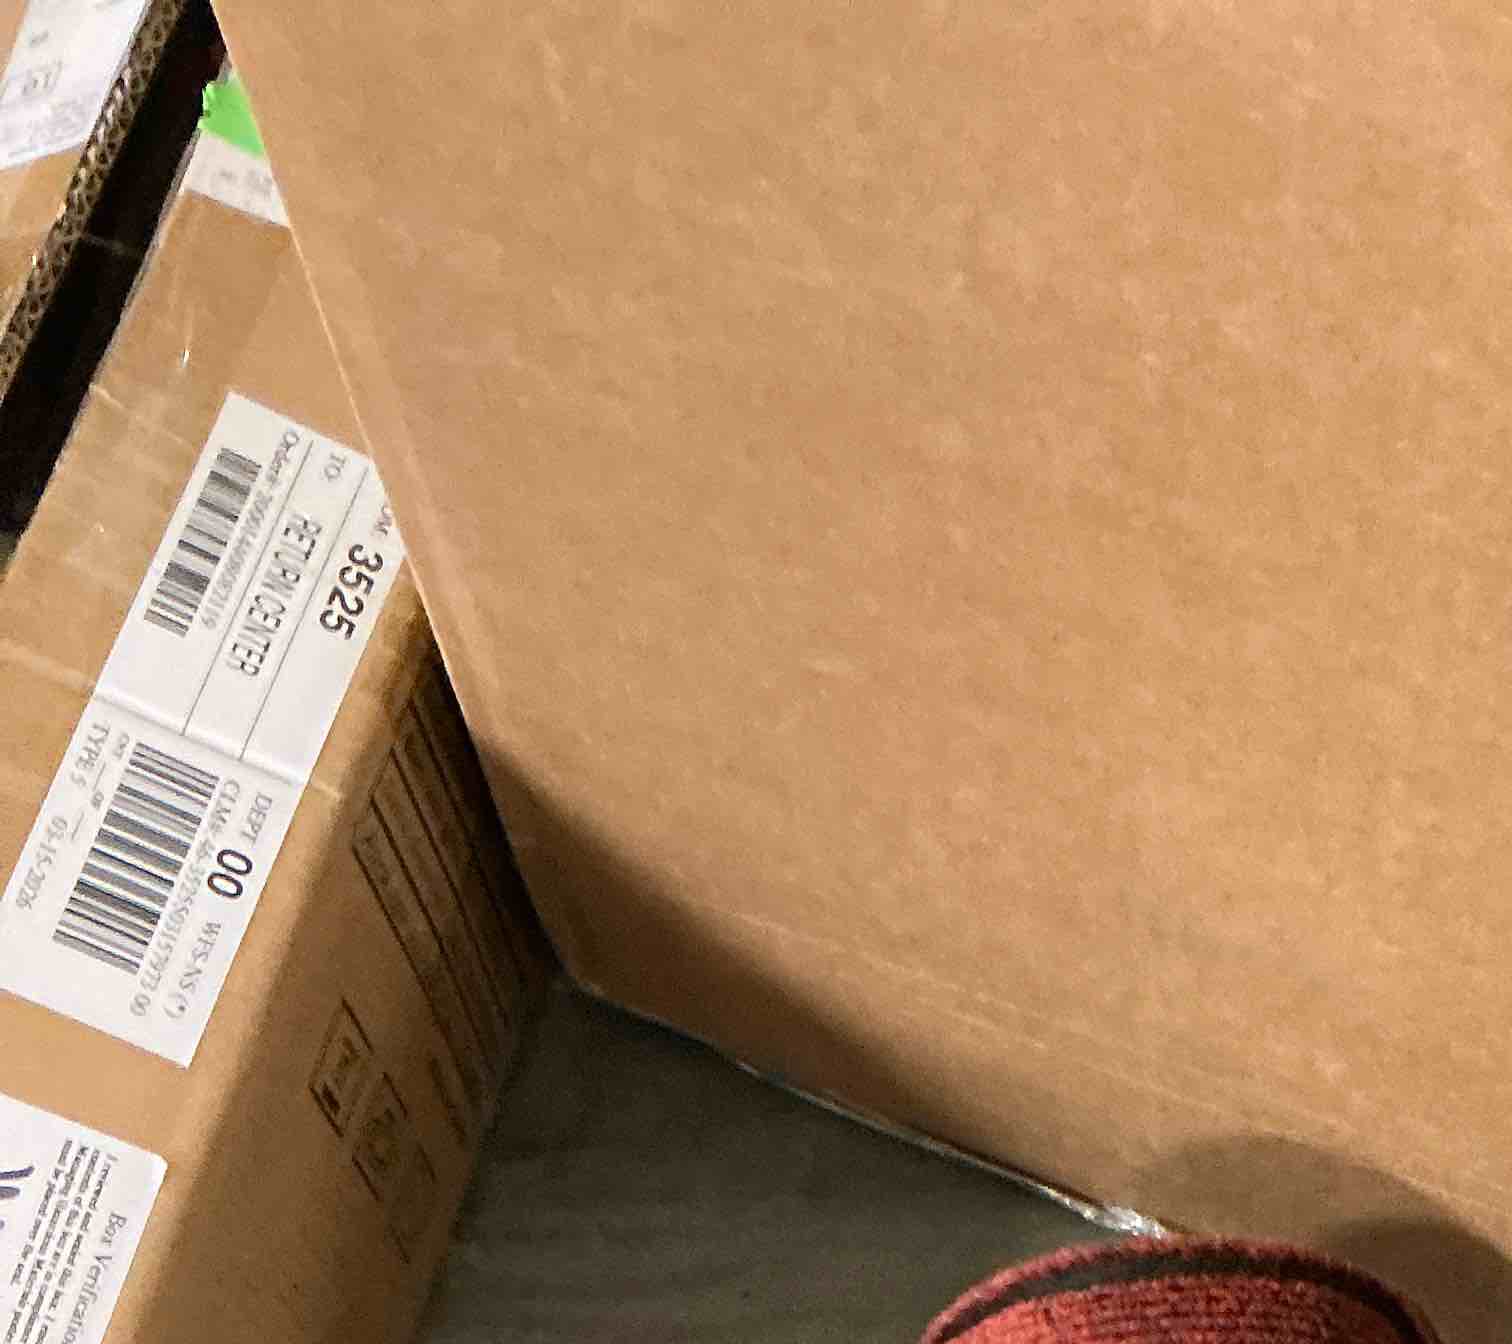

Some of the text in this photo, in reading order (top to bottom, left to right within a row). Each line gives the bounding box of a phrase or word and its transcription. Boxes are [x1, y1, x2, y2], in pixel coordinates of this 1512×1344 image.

[261, 510, 324, 599] RETURN
[316, 540, 386, 642] 3525
[224, 592, 288, 680] CENTER
[203, 844, 255, 903] 00
